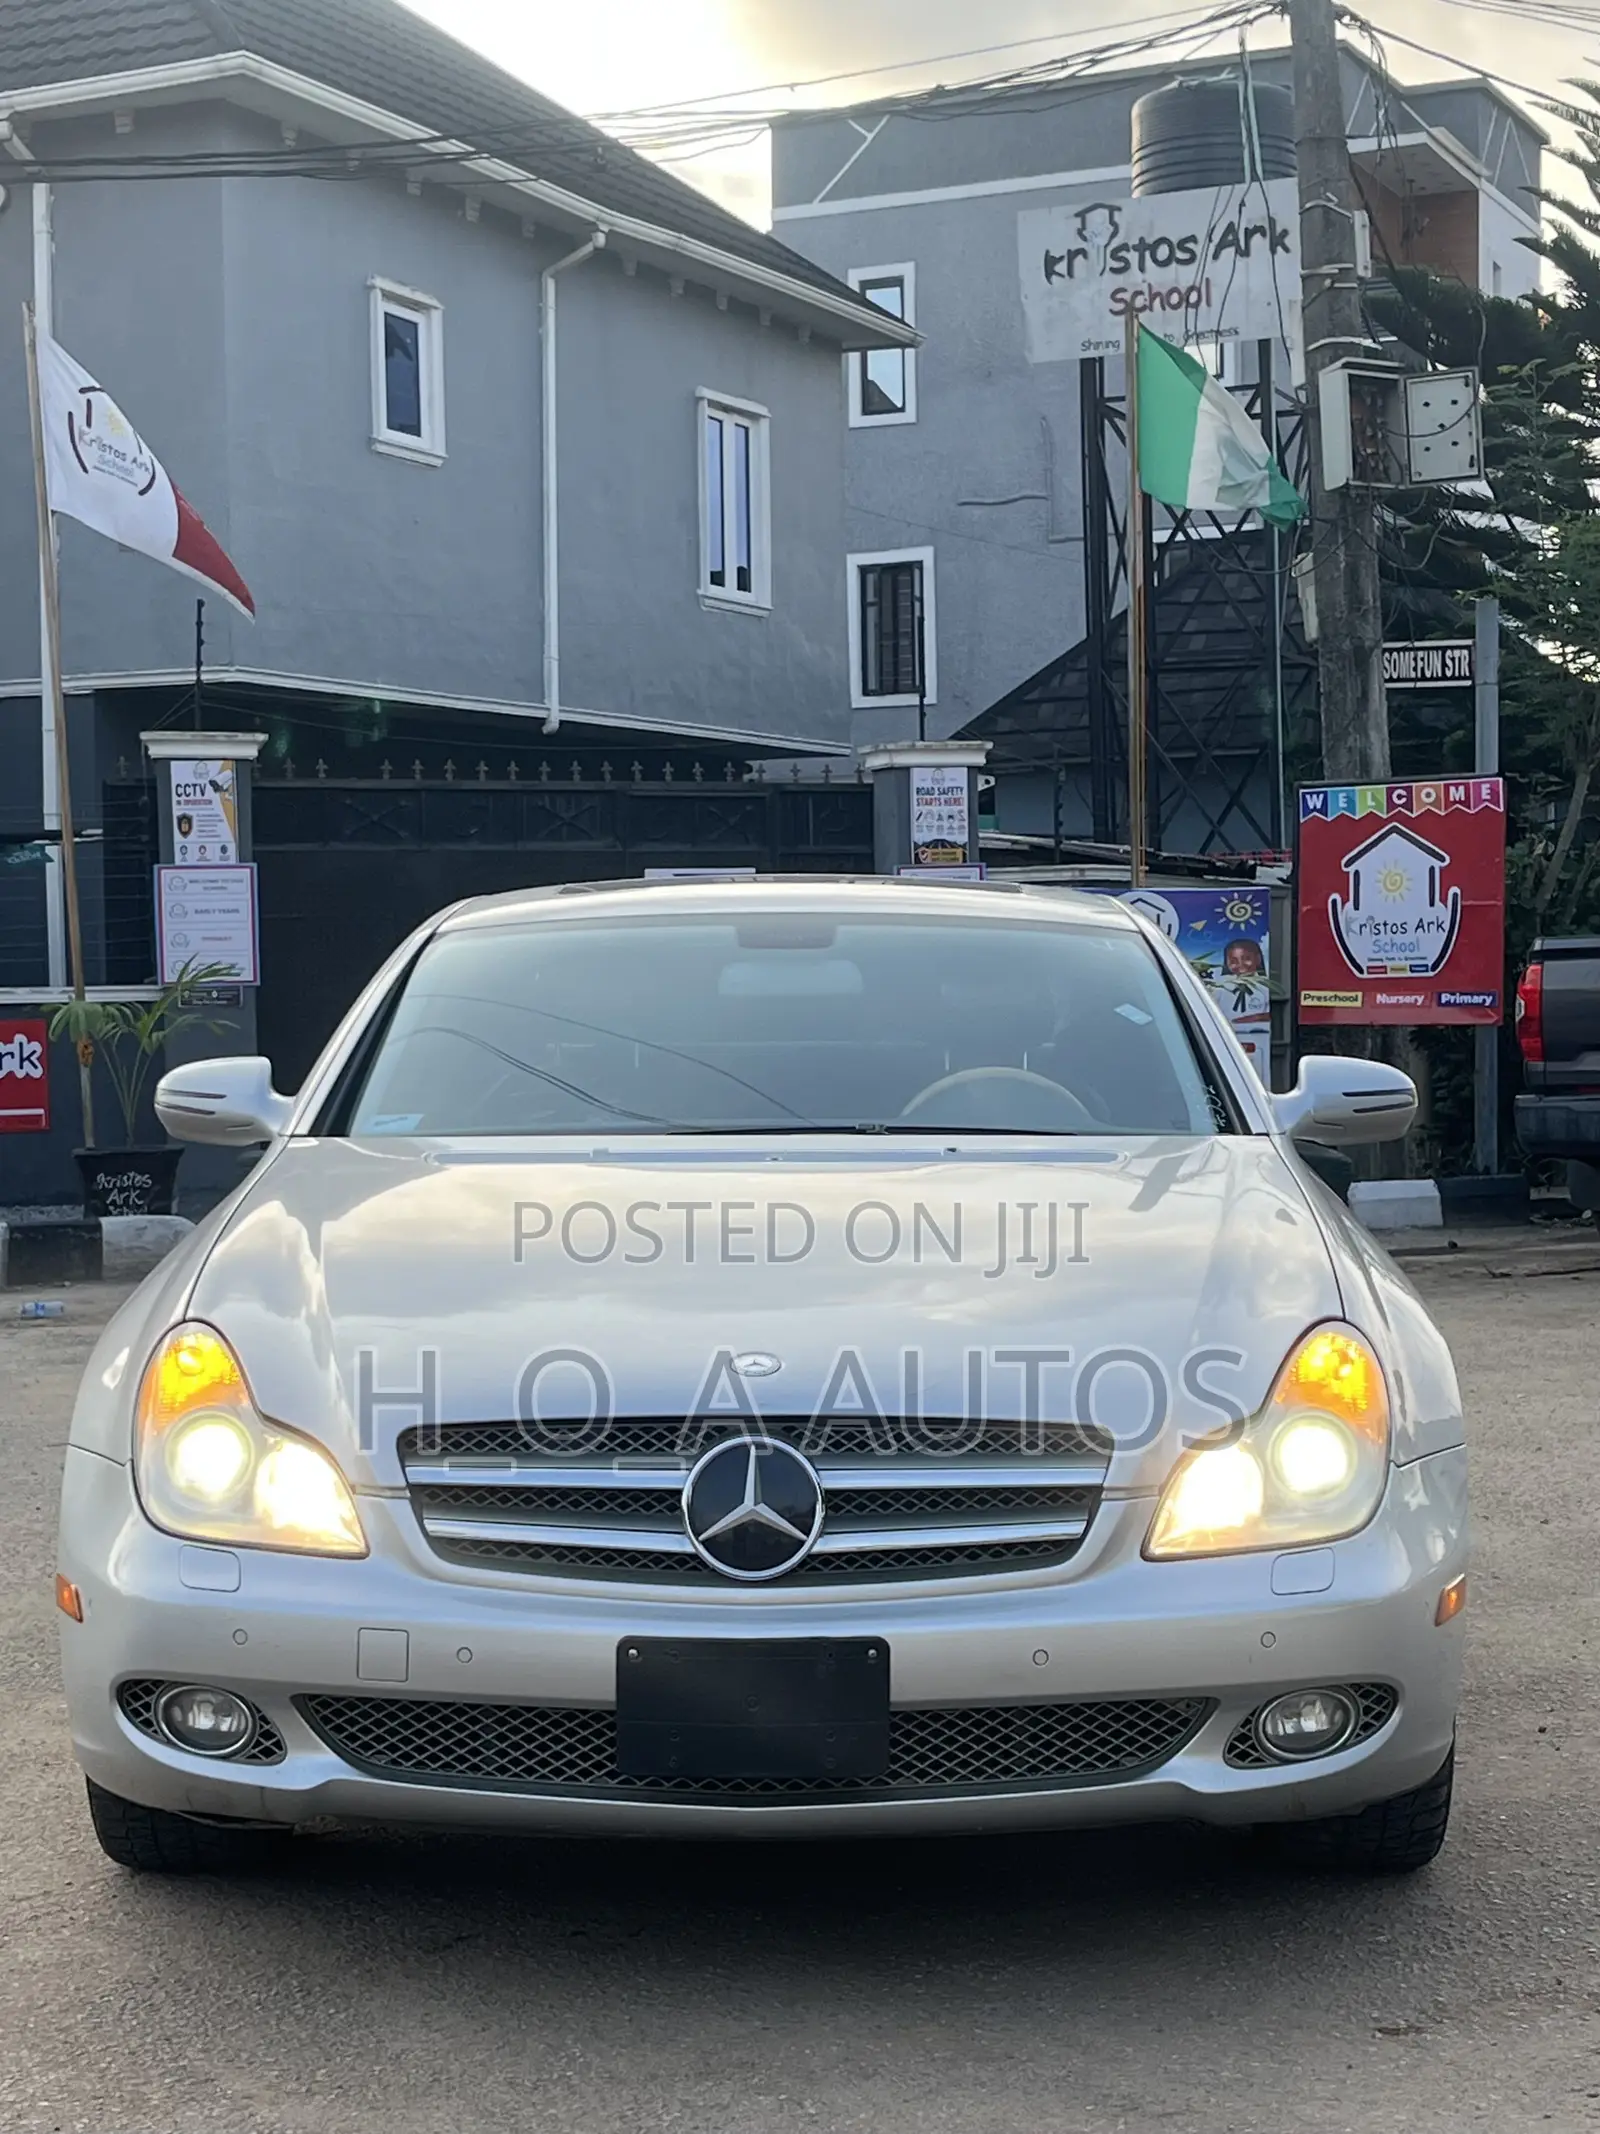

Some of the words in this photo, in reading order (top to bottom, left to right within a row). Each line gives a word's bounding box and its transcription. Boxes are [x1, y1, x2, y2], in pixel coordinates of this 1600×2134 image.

[1212, 217, 1291, 260] Ark
[1445, 649, 1470, 677] STR
[175, 783, 207, 798] CCTV
[916, 786, 935, 796] ROAD
[937, 786, 964, 796] SAFETY
[1305, 783, 1492, 810] WELCOME
[1345, 915, 1408, 938] Kristos
[1415, 916, 1446, 934] Ark
[1373, 937, 1420, 954] School
[1303, 993, 1359, 1004] Preschool
[1376, 993, 1425, 1005] Nursery
[1441, 993, 1493, 1006] Primary
